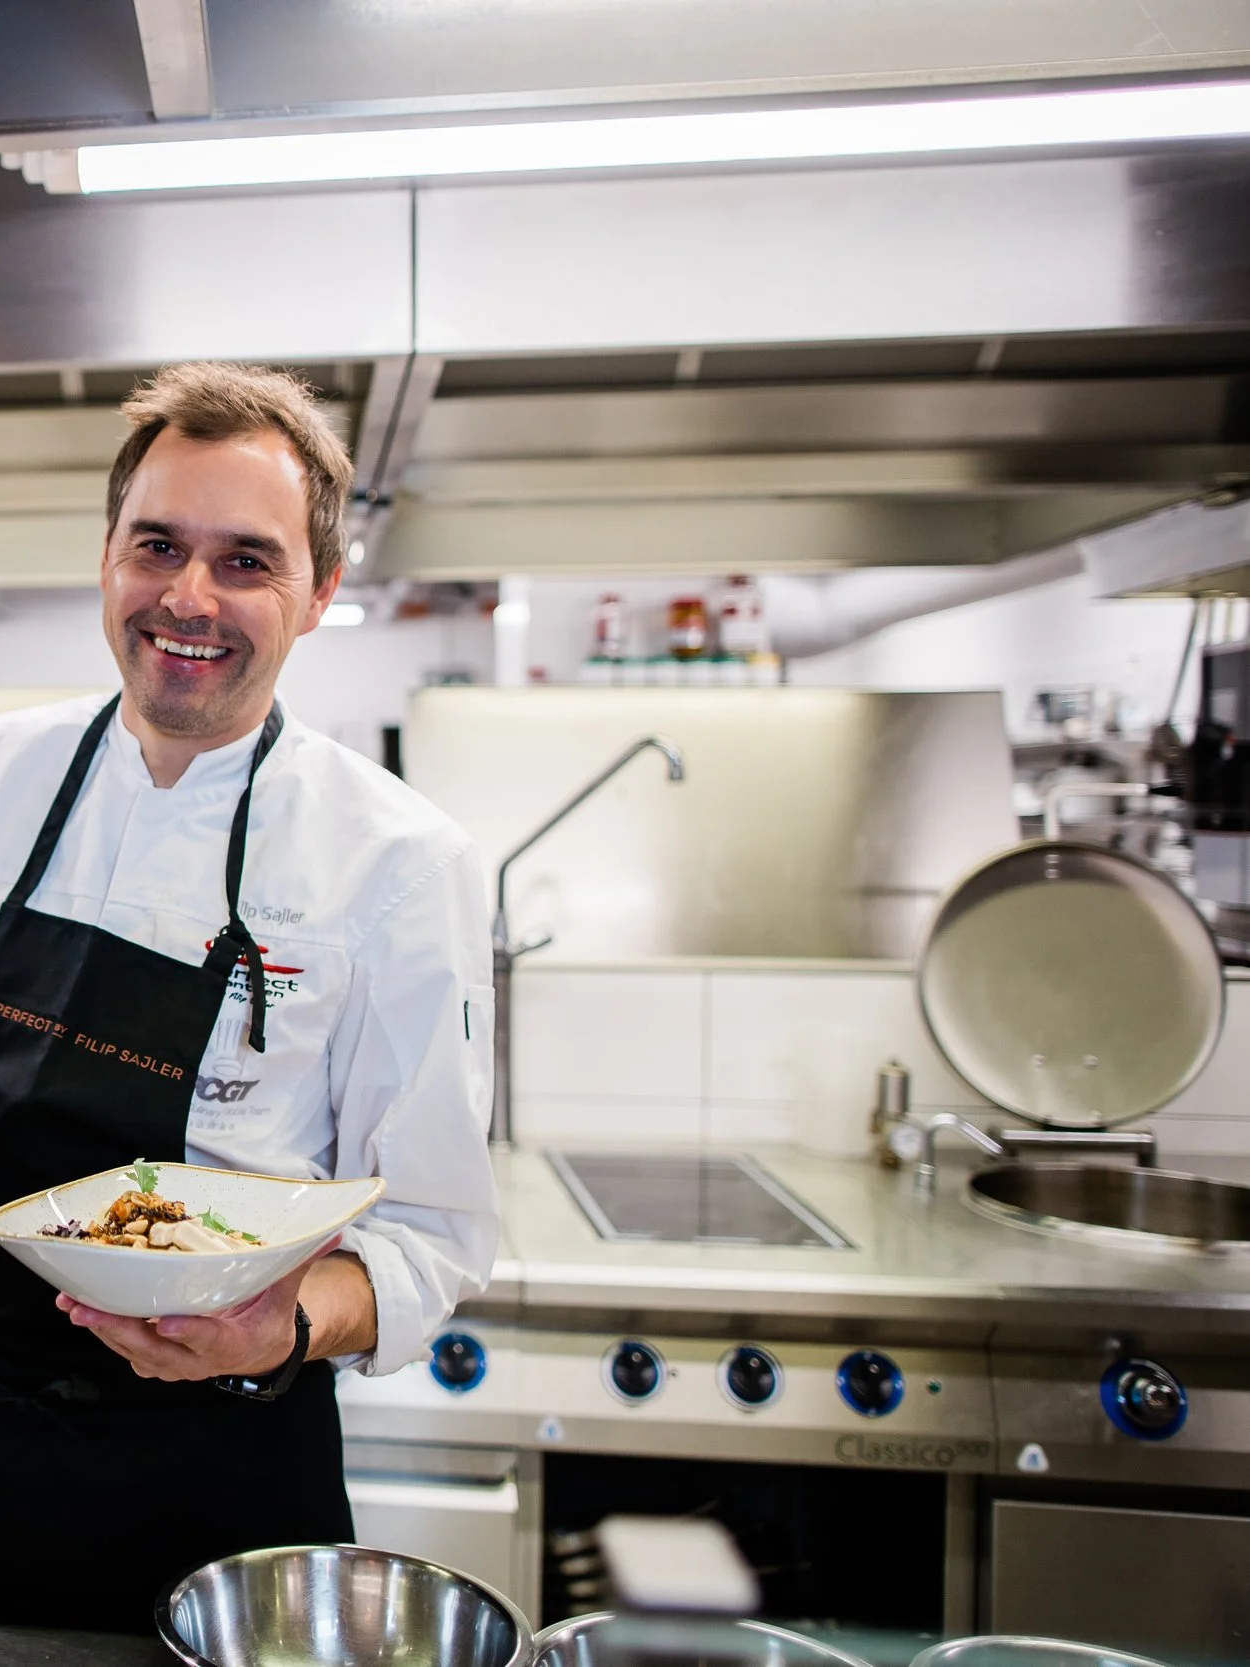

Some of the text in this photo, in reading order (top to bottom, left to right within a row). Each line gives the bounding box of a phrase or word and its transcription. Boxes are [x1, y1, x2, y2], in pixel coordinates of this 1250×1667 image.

[262, 906, 305, 926] Sajler
[53, 1023, 68, 1034] BY
[74, 1033, 117, 1056] FILIP
[119, 1049, 184, 1081] SAJLER
